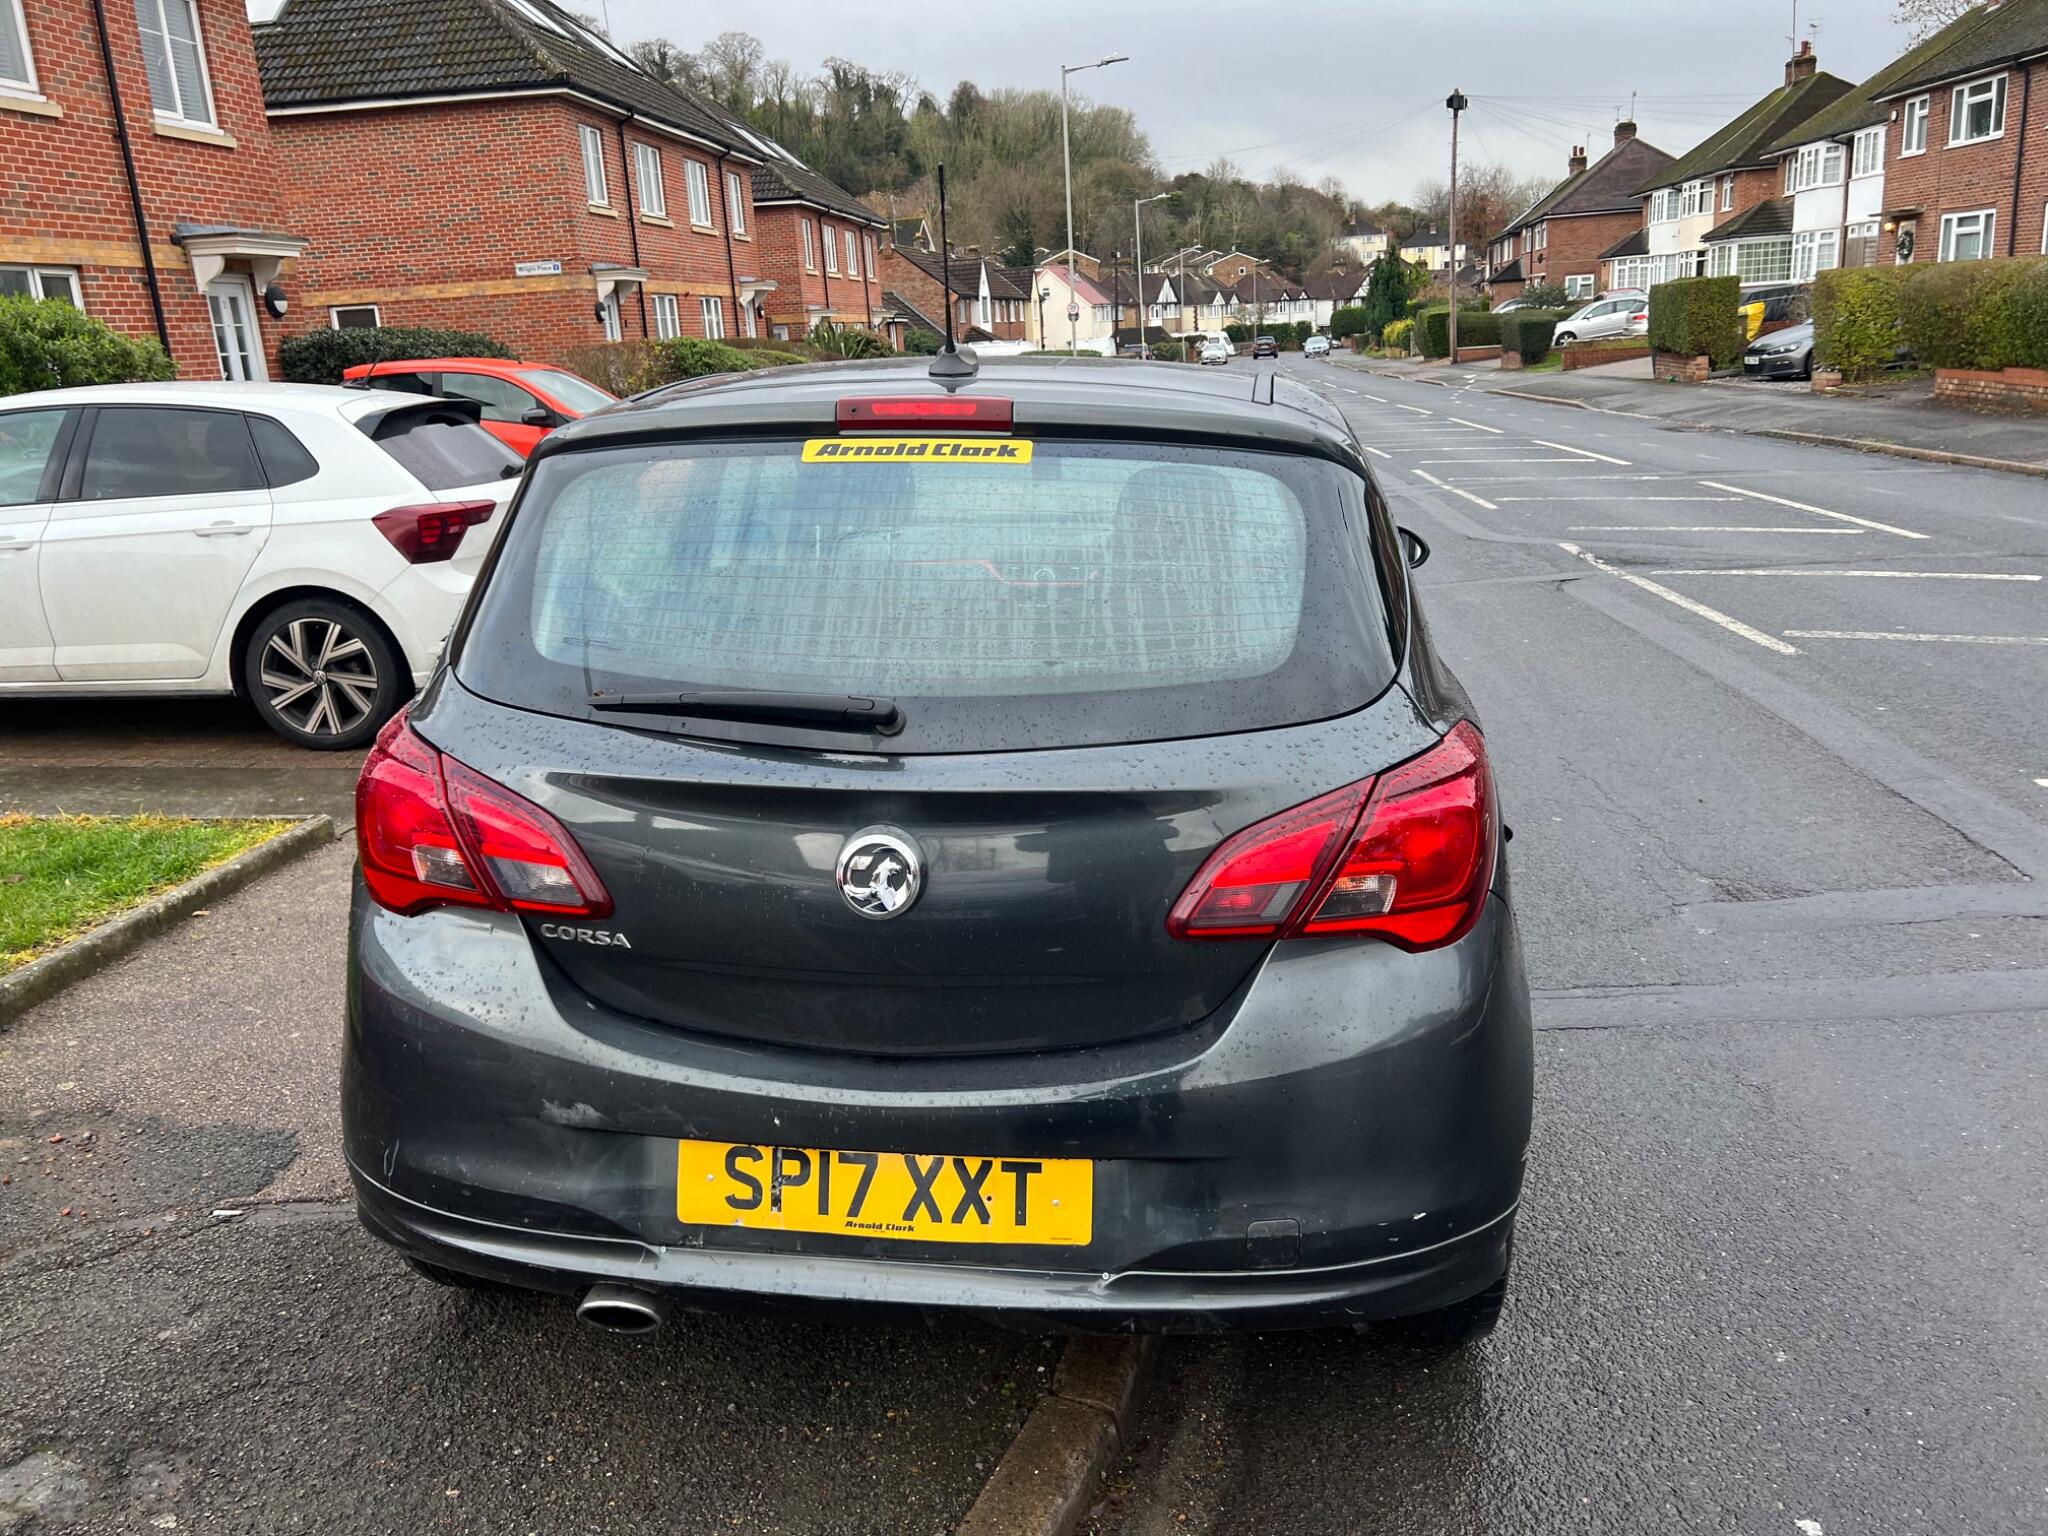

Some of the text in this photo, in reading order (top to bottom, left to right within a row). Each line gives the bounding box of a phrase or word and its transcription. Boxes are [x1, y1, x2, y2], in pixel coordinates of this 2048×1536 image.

[815, 443, 1019, 457] Arnold Clark
[541, 923, 632, 949] CORSA
[724, 1145, 1043, 1226] SP17 XXT
[845, 1220, 883, 1230] Arnold
[886, 1223, 915, 1232] Clark
